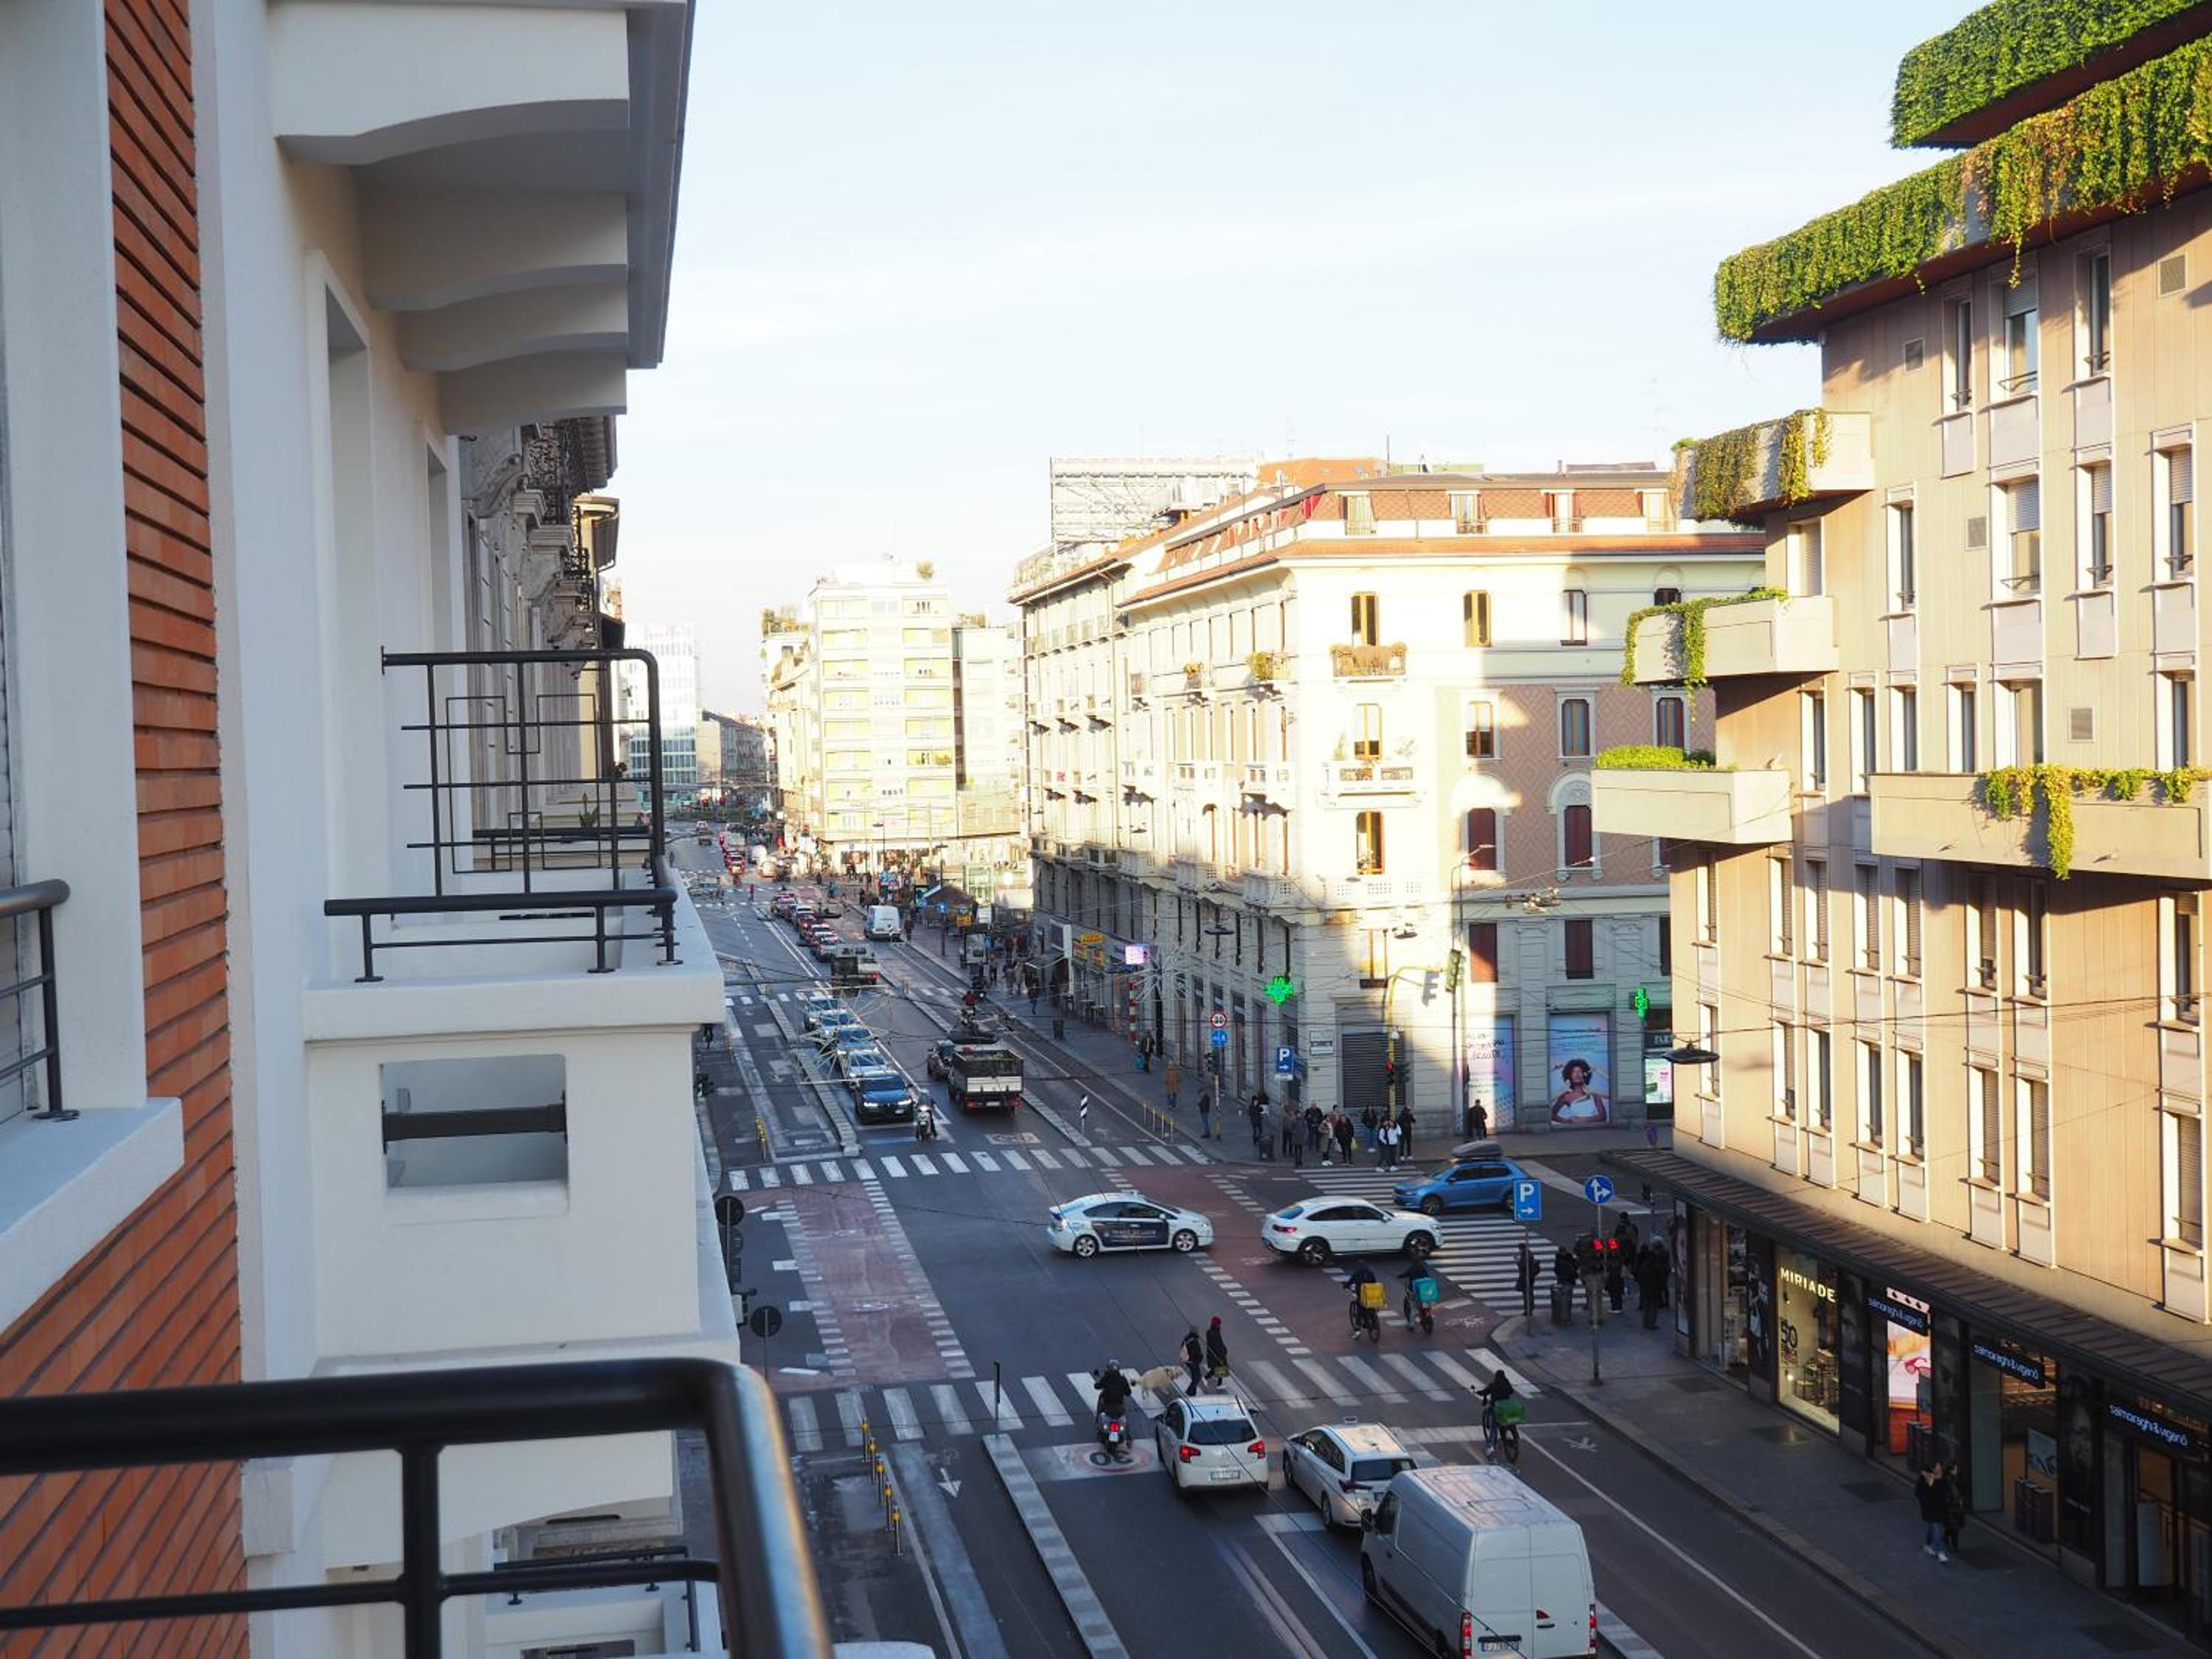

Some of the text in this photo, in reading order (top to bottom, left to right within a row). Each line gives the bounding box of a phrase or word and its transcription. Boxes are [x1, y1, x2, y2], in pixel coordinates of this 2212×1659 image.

[1279, 1048, 1290, 1062] P
[1520, 1183, 1534, 1203] P
[1781, 1267, 1835, 1303] MIRIADE
